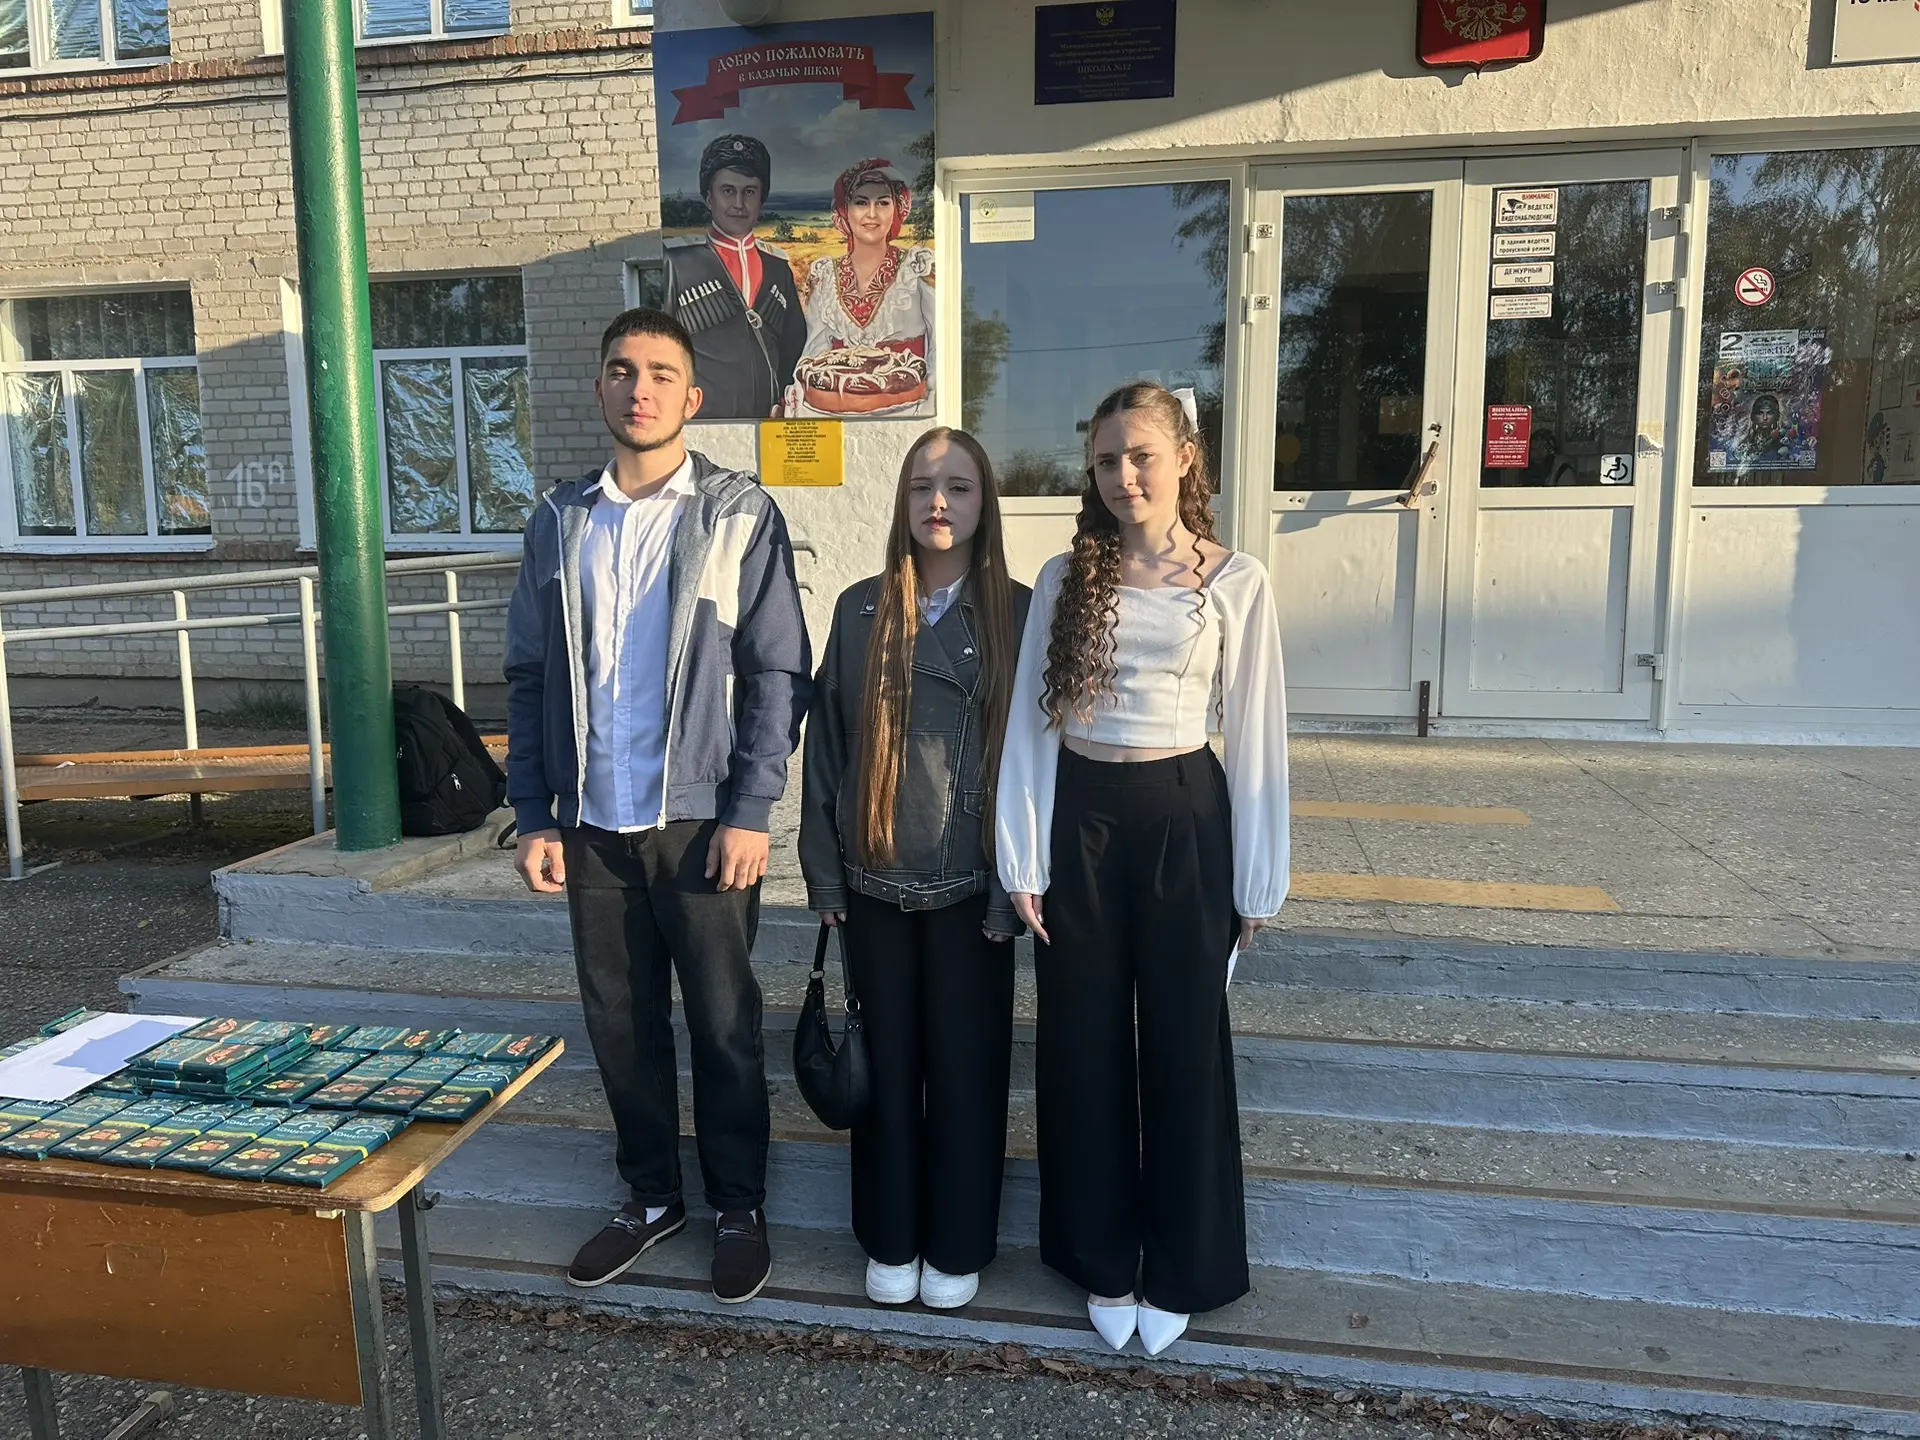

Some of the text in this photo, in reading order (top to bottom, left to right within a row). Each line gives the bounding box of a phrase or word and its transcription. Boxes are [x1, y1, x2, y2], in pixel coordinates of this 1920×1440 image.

[716, 45, 865, 73] ДОБРО ПОЖАЛОВАТЬ
[1078, 65, 1112, 74] ШКОЛА
[1501, 214, 1552, 222] ВИДЕОНАБЛЮДЕНИЕ
[1504, 267, 1543, 276] ДЕЖУРНЫЙ
[1721, 334, 1742, 351] 2
